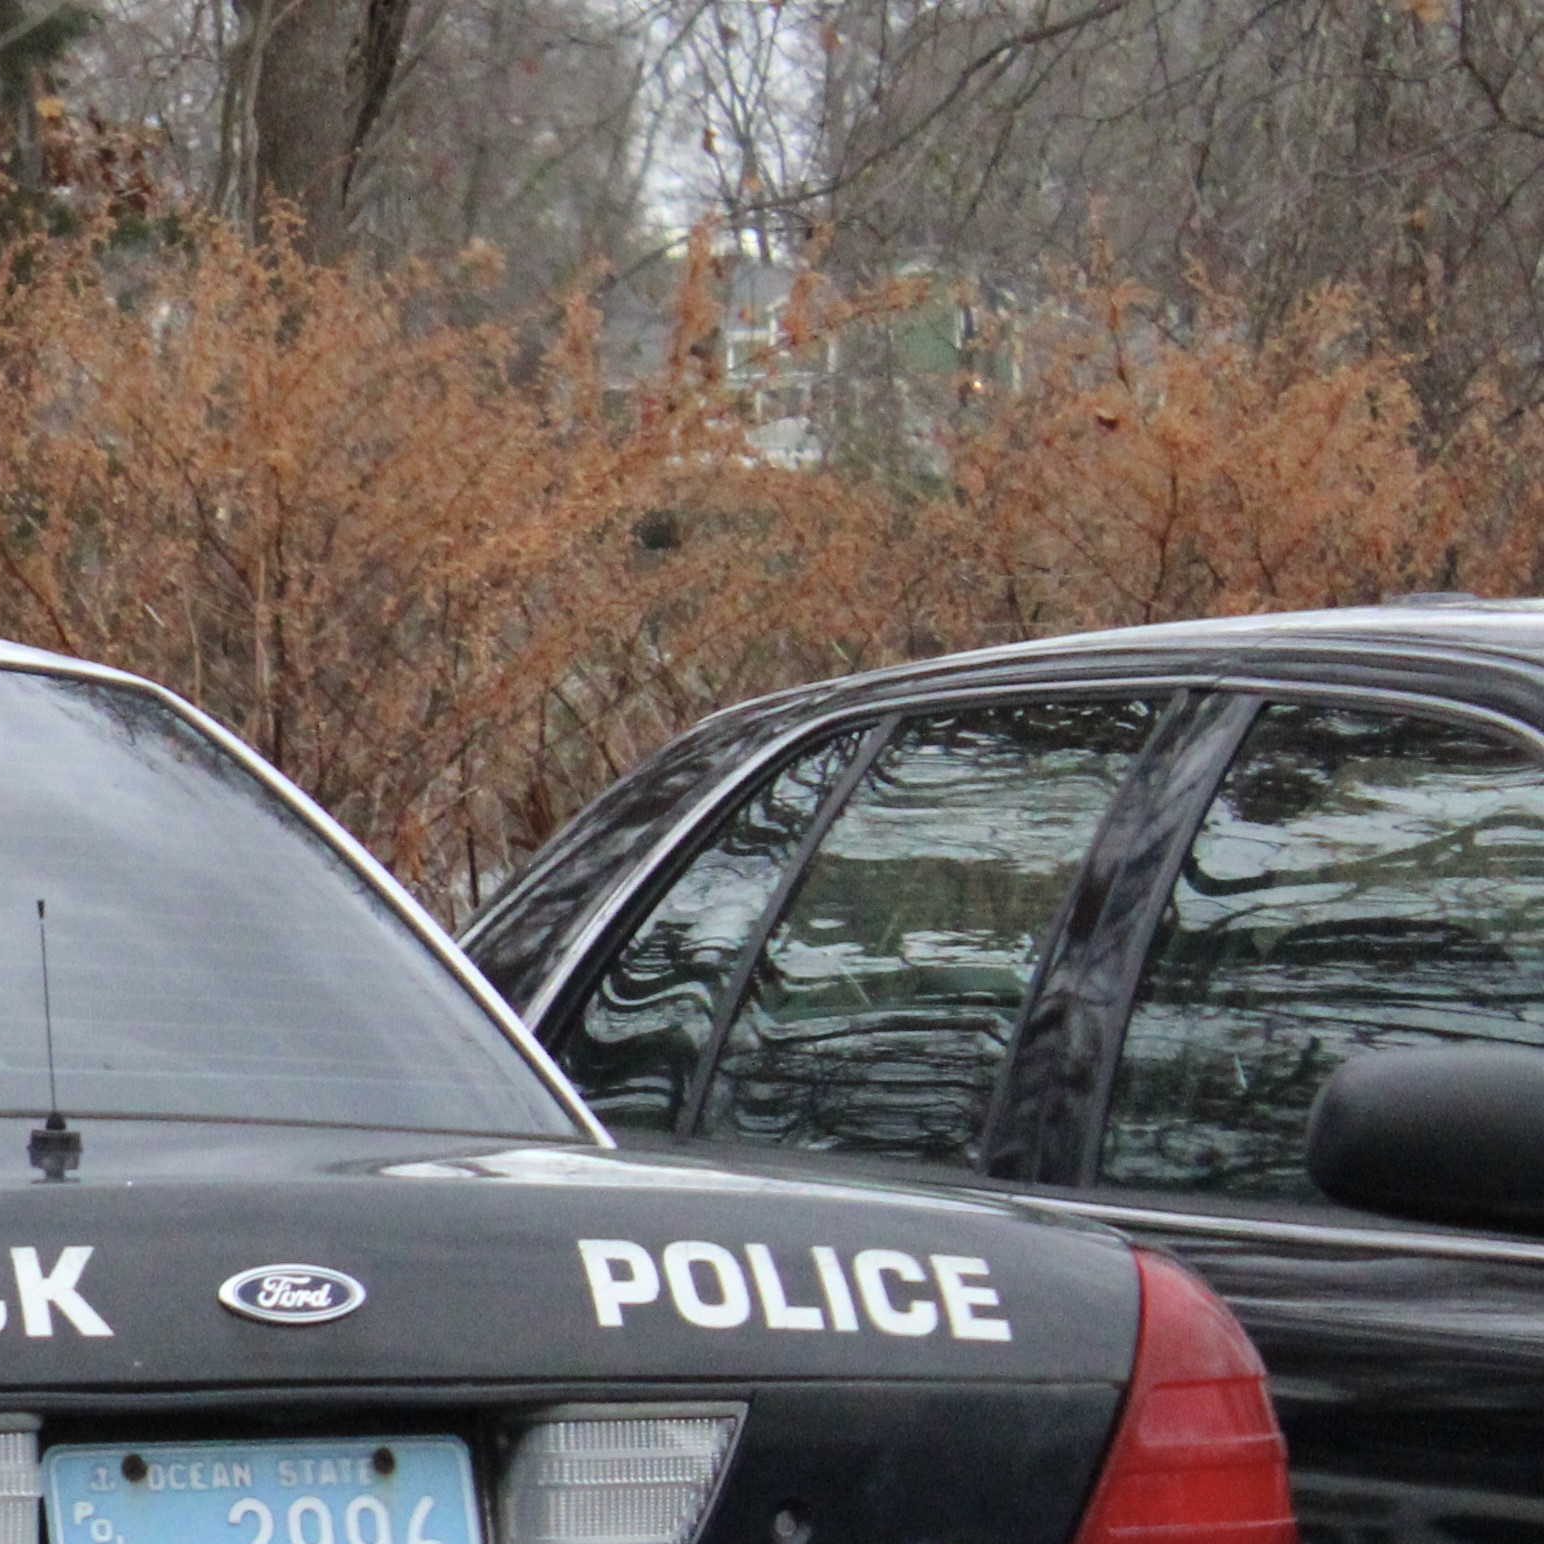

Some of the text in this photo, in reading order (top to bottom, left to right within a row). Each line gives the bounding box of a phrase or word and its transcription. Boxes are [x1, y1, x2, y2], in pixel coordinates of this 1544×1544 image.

[257, 1275, 333, 1308] Ford
[577, 1238, 1012, 1342] POLICE
[146, 1456, 374, 1492] OCEAN STATE
